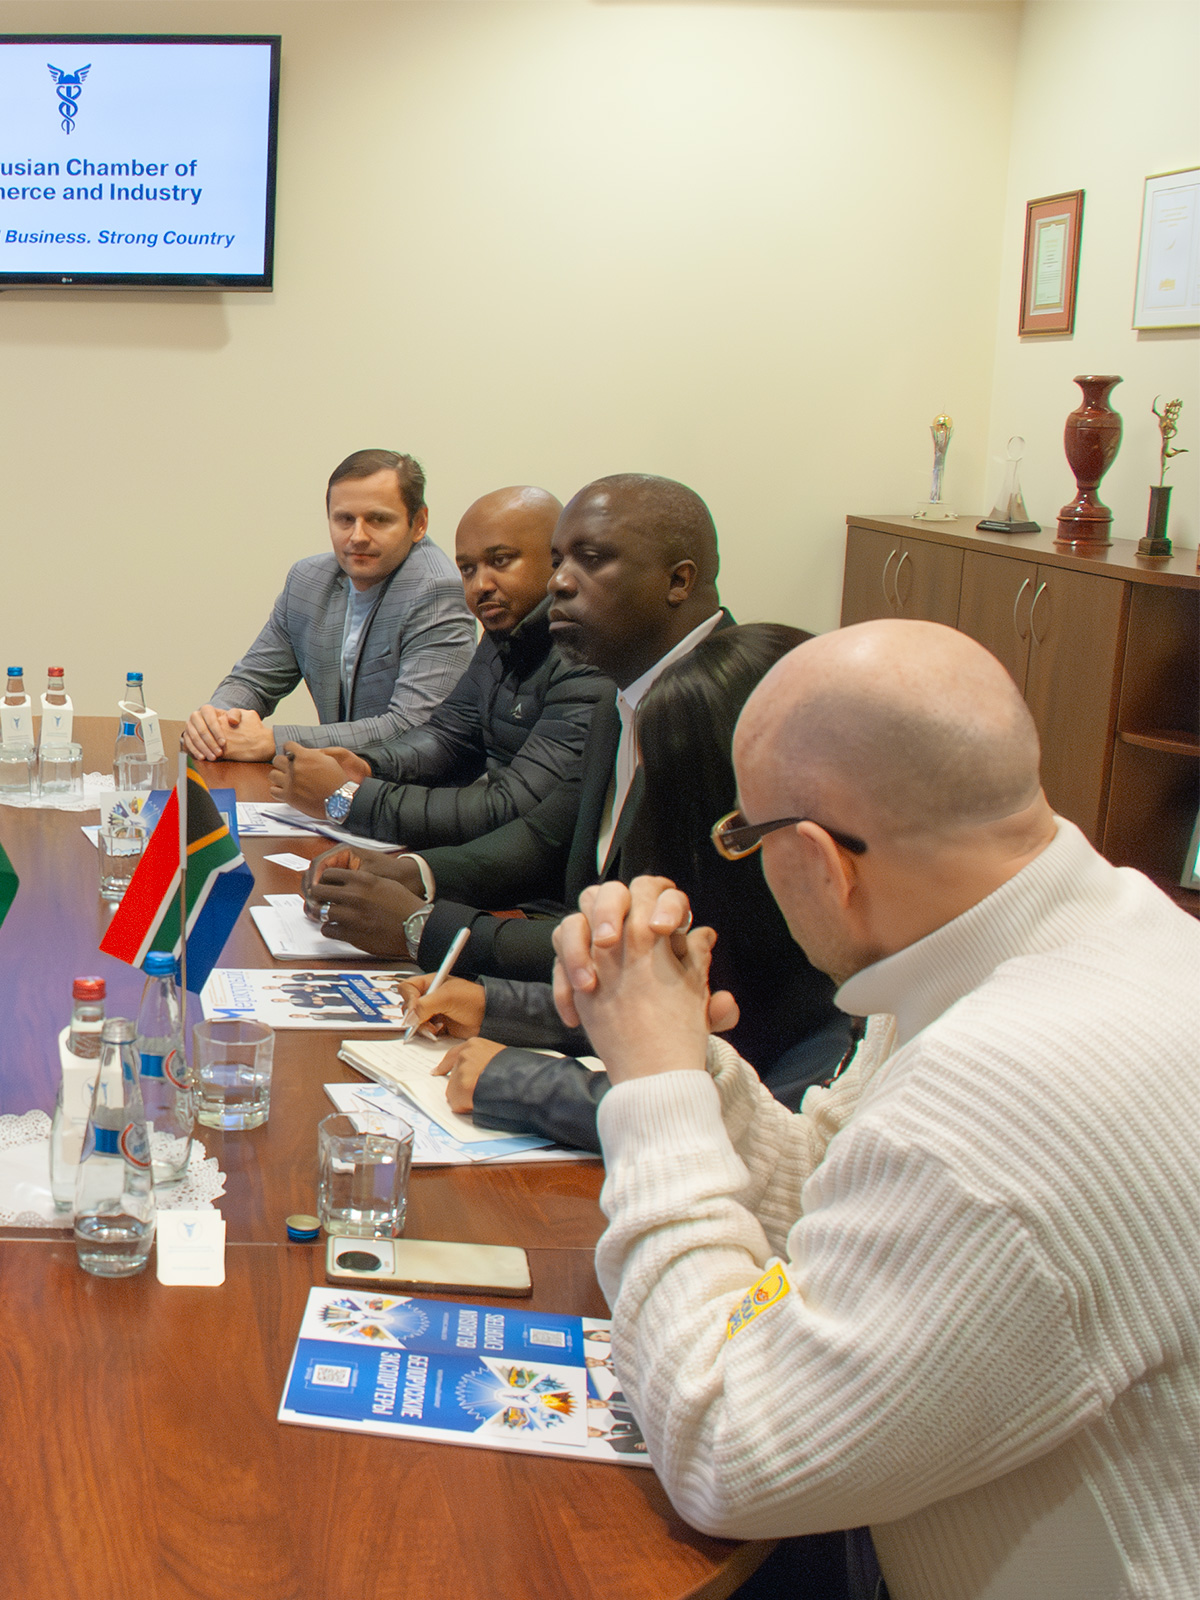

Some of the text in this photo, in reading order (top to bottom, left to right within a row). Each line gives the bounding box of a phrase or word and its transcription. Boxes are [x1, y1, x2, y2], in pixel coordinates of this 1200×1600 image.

[65, 157, 170, 177] Chamber
[174, 158, 198, 177] of
[62, 182, 103, 201] and
[109, 182, 203, 206] Industry
[4, 229, 91, 245] Business.
[97, 229, 159, 248] Strong
[162, 230, 236, 249] Country
[456, 1309, 478, 1349] BELARUSIAN
[483, 1313, 505, 1351] EXPORTERS
[371, 1350, 401, 1416] ЭКСПОРТЕРЫ
[400, 1353, 429, 1420] БЕЛОРУССКИЕ
